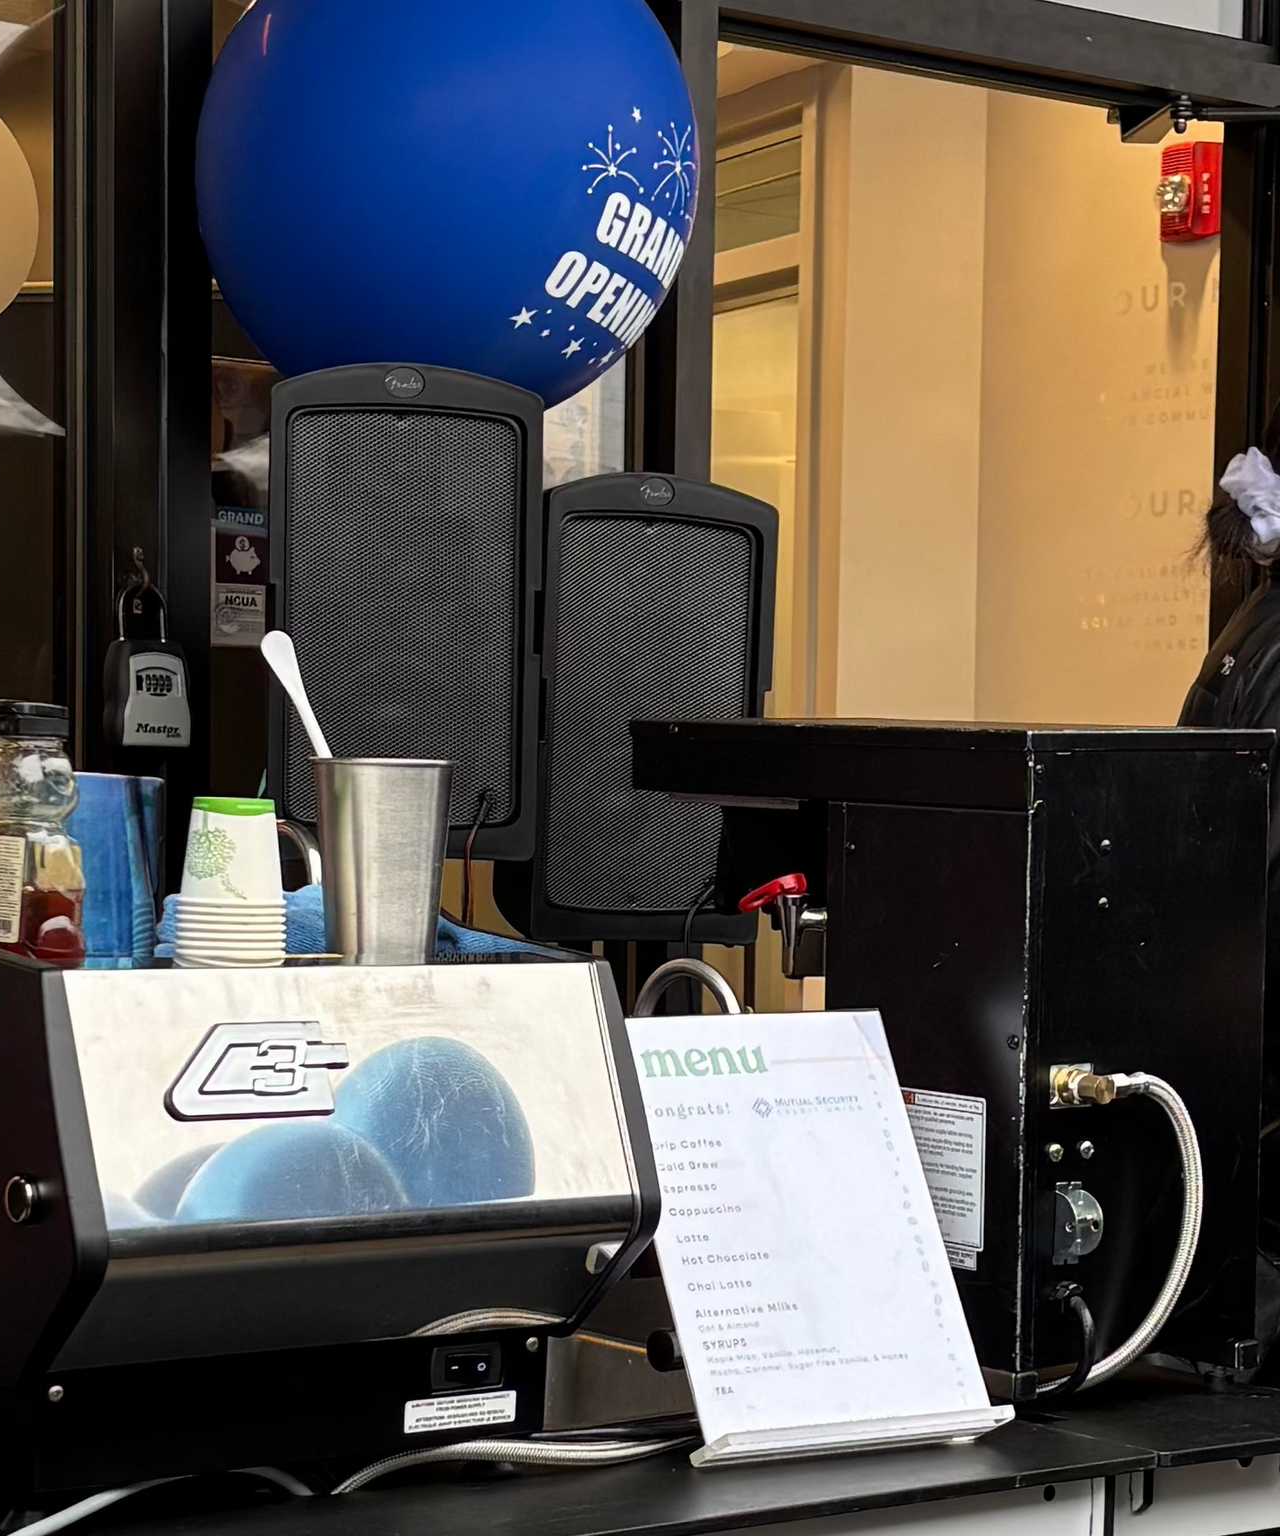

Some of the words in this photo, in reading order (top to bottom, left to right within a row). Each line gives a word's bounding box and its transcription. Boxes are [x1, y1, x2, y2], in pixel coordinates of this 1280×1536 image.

[1201, 172, 1211, 214] FIRE
[596, 191, 685, 289] GRAND
[218, 510, 263, 525] GRAND
[135, 723, 179, 735] Master
[640, 1045, 768, 1079] menu
[681, 1138, 722, 1149] Coffee
[689, 1160, 718, 1170] Brew
[663, 1182, 718, 1194] Espresso
[669, 1204, 742, 1217] Cappuccino
[677, 1234, 709, 1244] Latte
[681, 1255, 703, 1266] Hot
[707, 1251, 770, 1264] Chocolate
[688, 1280, 715, 1292] Chai
[721, 1278, 752, 1290] Latte
[695, 1304, 763, 1319] Alternative
[768, 1301, 798, 1312] Milks
[702, 1337, 747, 1350] SYRUPS
[714, 1386, 734, 1396] TEA
